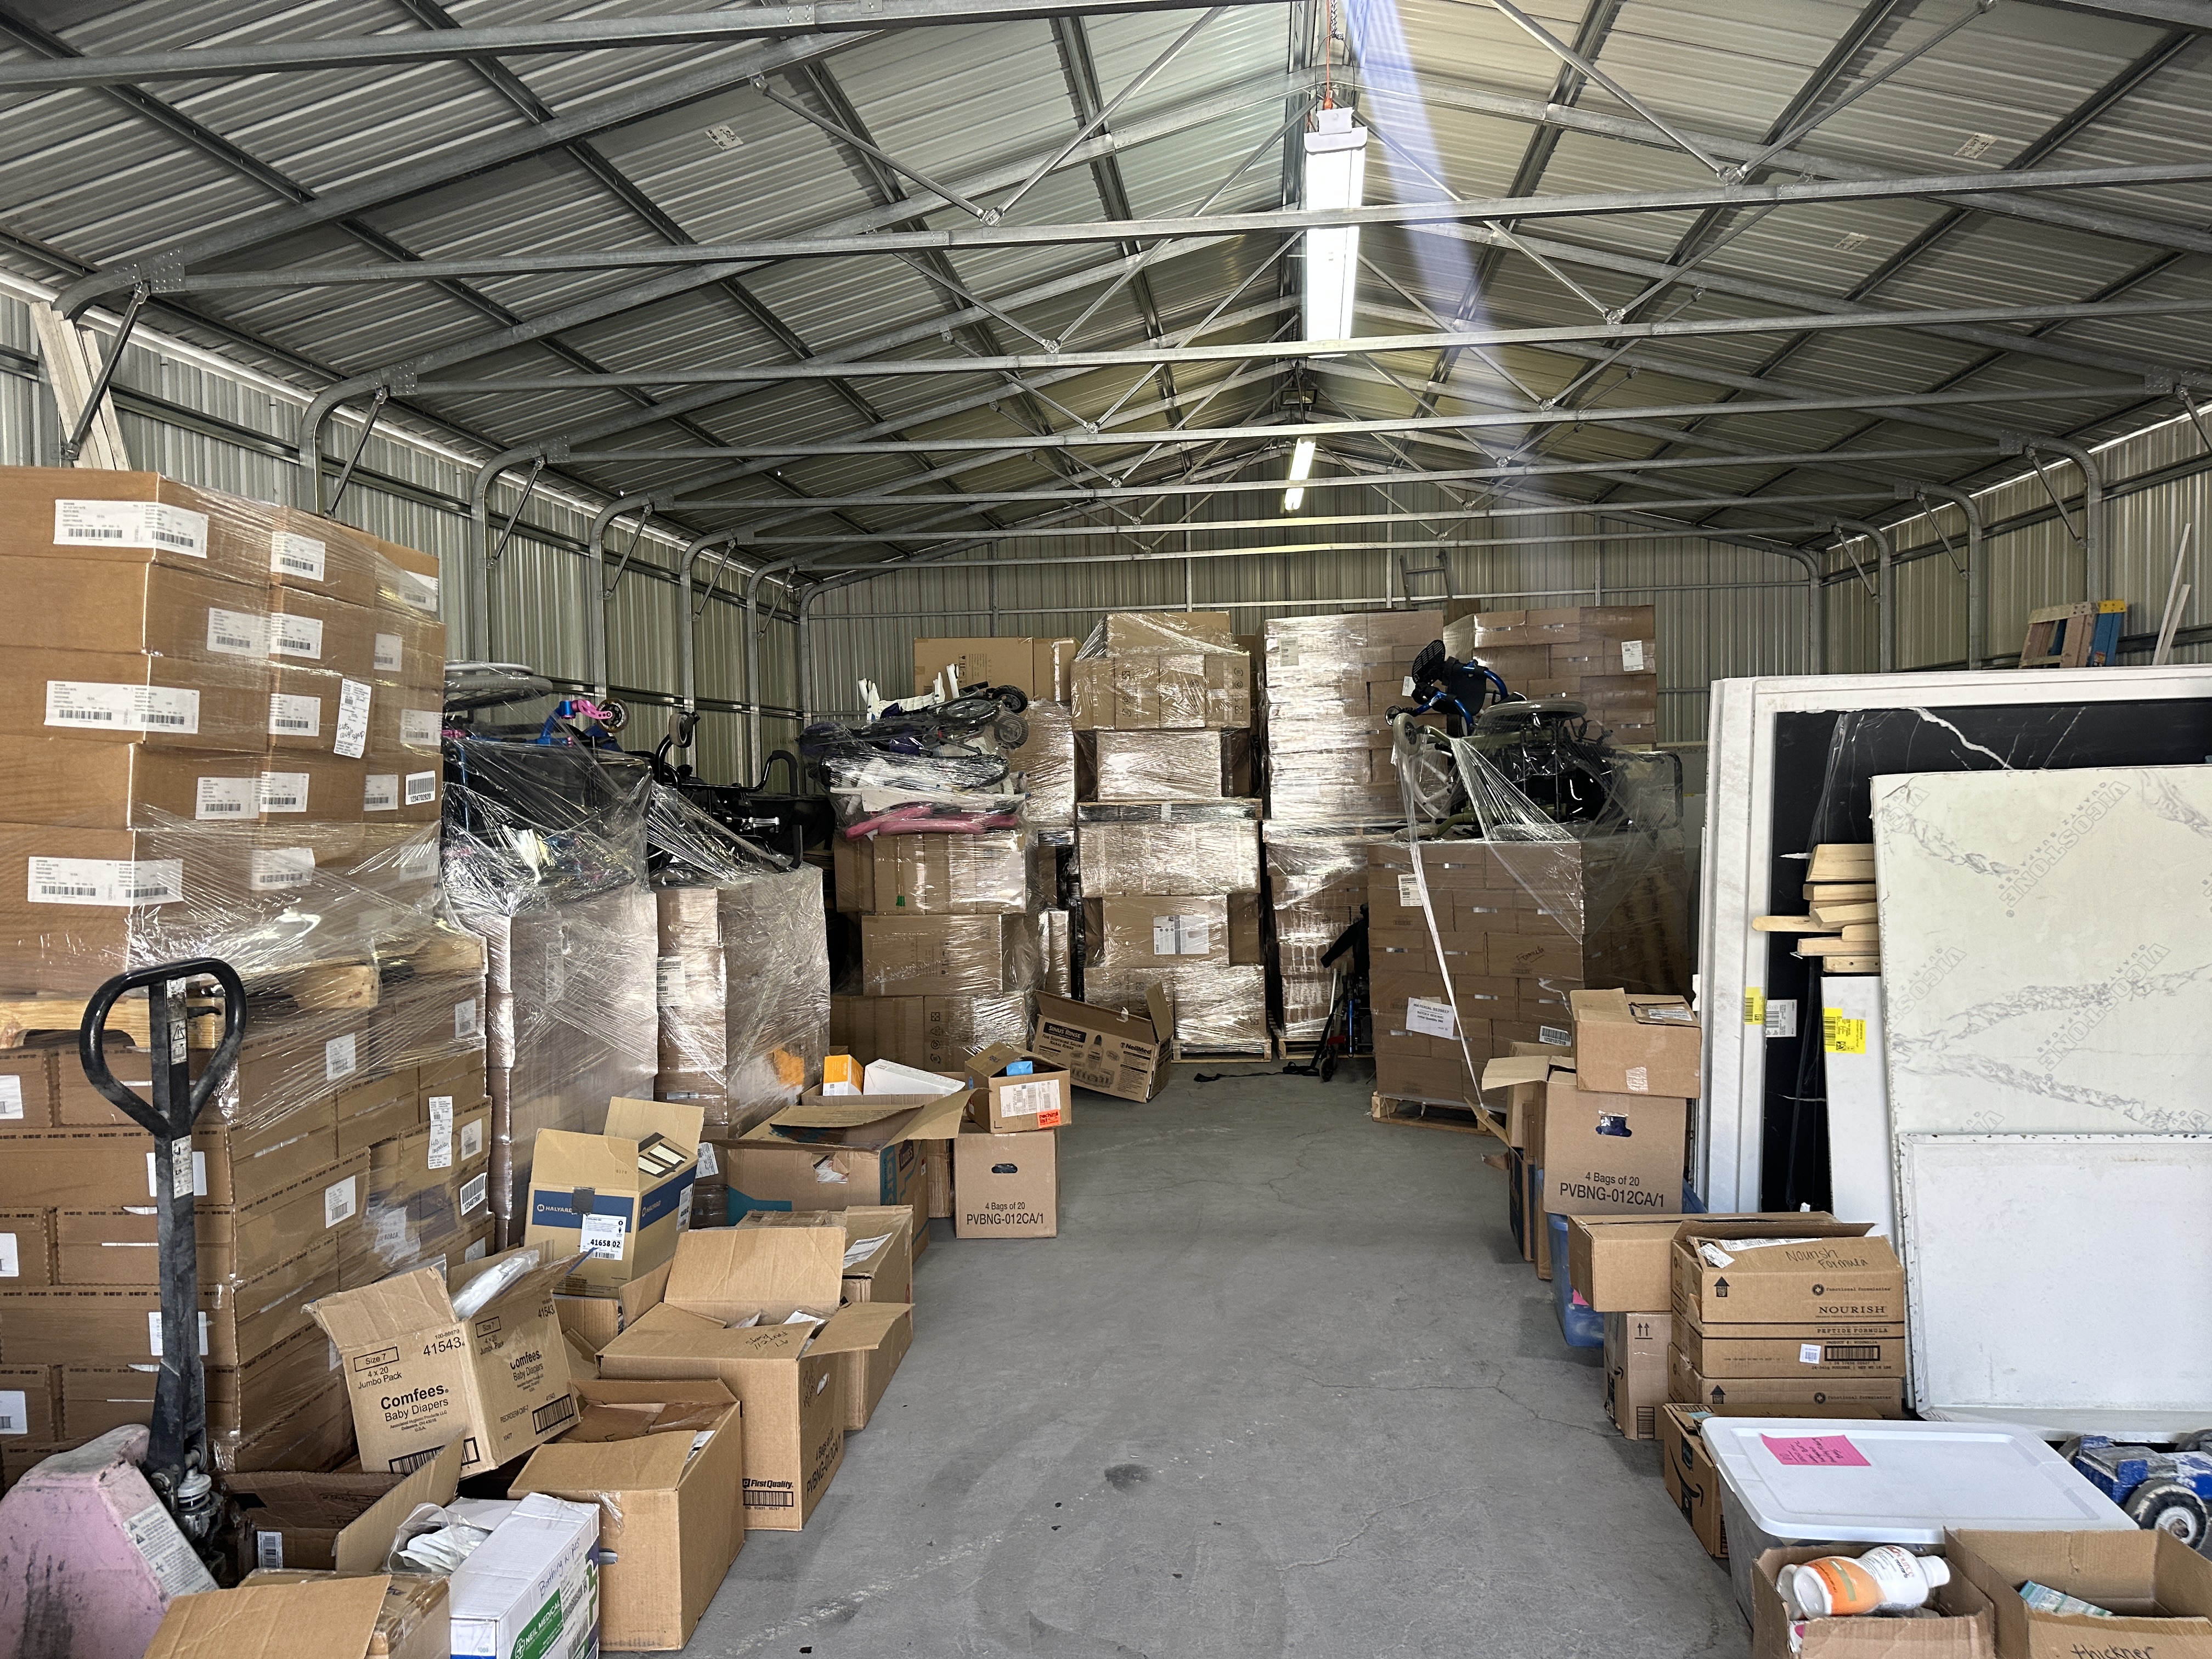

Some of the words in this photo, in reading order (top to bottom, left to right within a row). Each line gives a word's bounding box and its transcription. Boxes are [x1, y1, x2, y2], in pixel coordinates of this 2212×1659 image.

[1048, 1025, 1065, 1034] SINUS
[1065, 1030, 1081, 1039] RINSE
[1125, 1045, 1152, 1054] NeilMed
[1585, 1172, 1591, 1181] 4
[1594, 1172, 1616, 1186] Bags
[1618, 1175, 1627, 1184] of
[1629, 1176, 1640, 1186] 20
[1560, 1182, 1664, 1207] PVBNG-012CA/1
[991, 1202, 1008, 1211] Bags
[967, 1212, 1043, 1225] PVBNG-012CA/1
[590, 1239, 611, 1247] 41658
[482, 1323, 491, 1331] Size
[423, 1336, 462, 1356] 41543
[365, 1356, 381, 1365] Size
[380, 1366, 388, 1374] 20
[513, 1370, 526, 1381] Baby
[358, 1378, 382, 1389] Jumbo
[383, 1372, 402, 1383] Pack
[385, 1408, 409, 1422] Baby
[411, 1399, 449, 1415] Diapers
[751, 1479, 766, 1487] First
[525, 1628, 538, 1646] NEIL
[539, 1600, 561, 1630] MEDICAL
